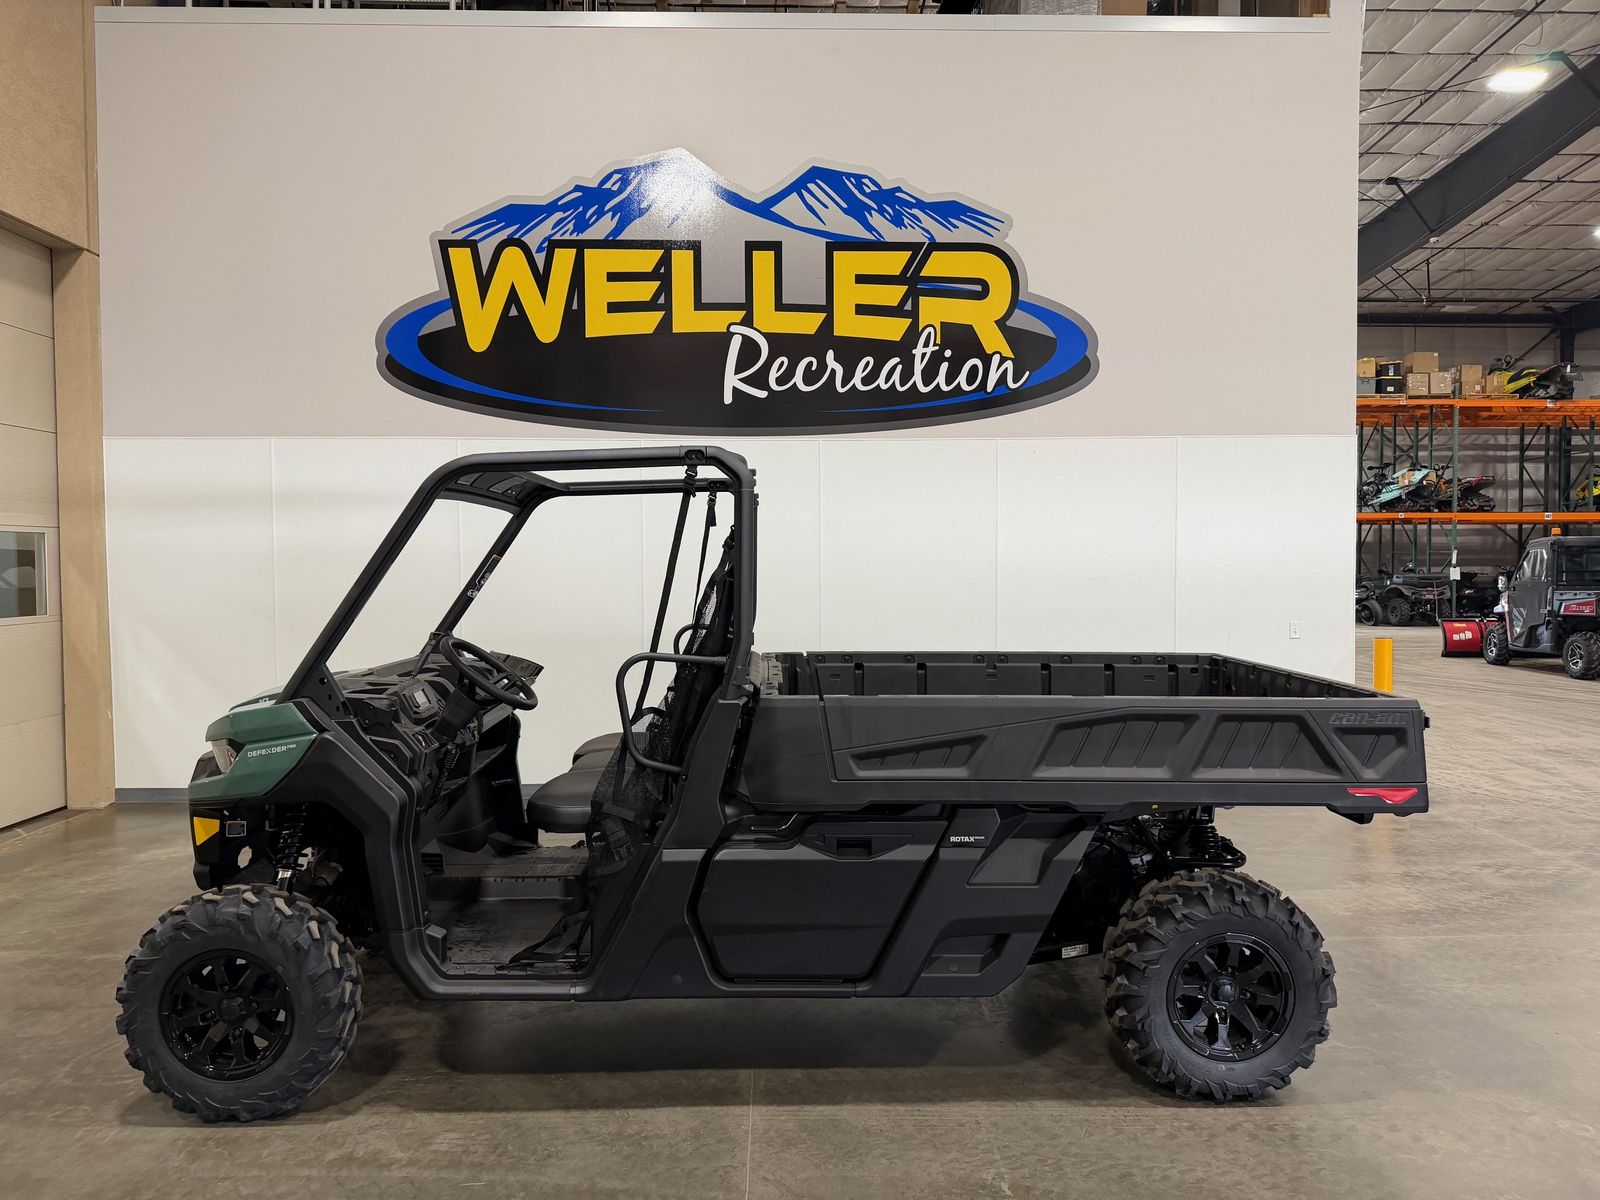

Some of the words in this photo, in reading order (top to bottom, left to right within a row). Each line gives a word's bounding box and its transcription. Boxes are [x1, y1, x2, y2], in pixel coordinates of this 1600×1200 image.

[447, 246, 1015, 358] WELLER
[722, 323, 1031, 405] Recreation
[247, 745, 287, 757] DEFENDER
